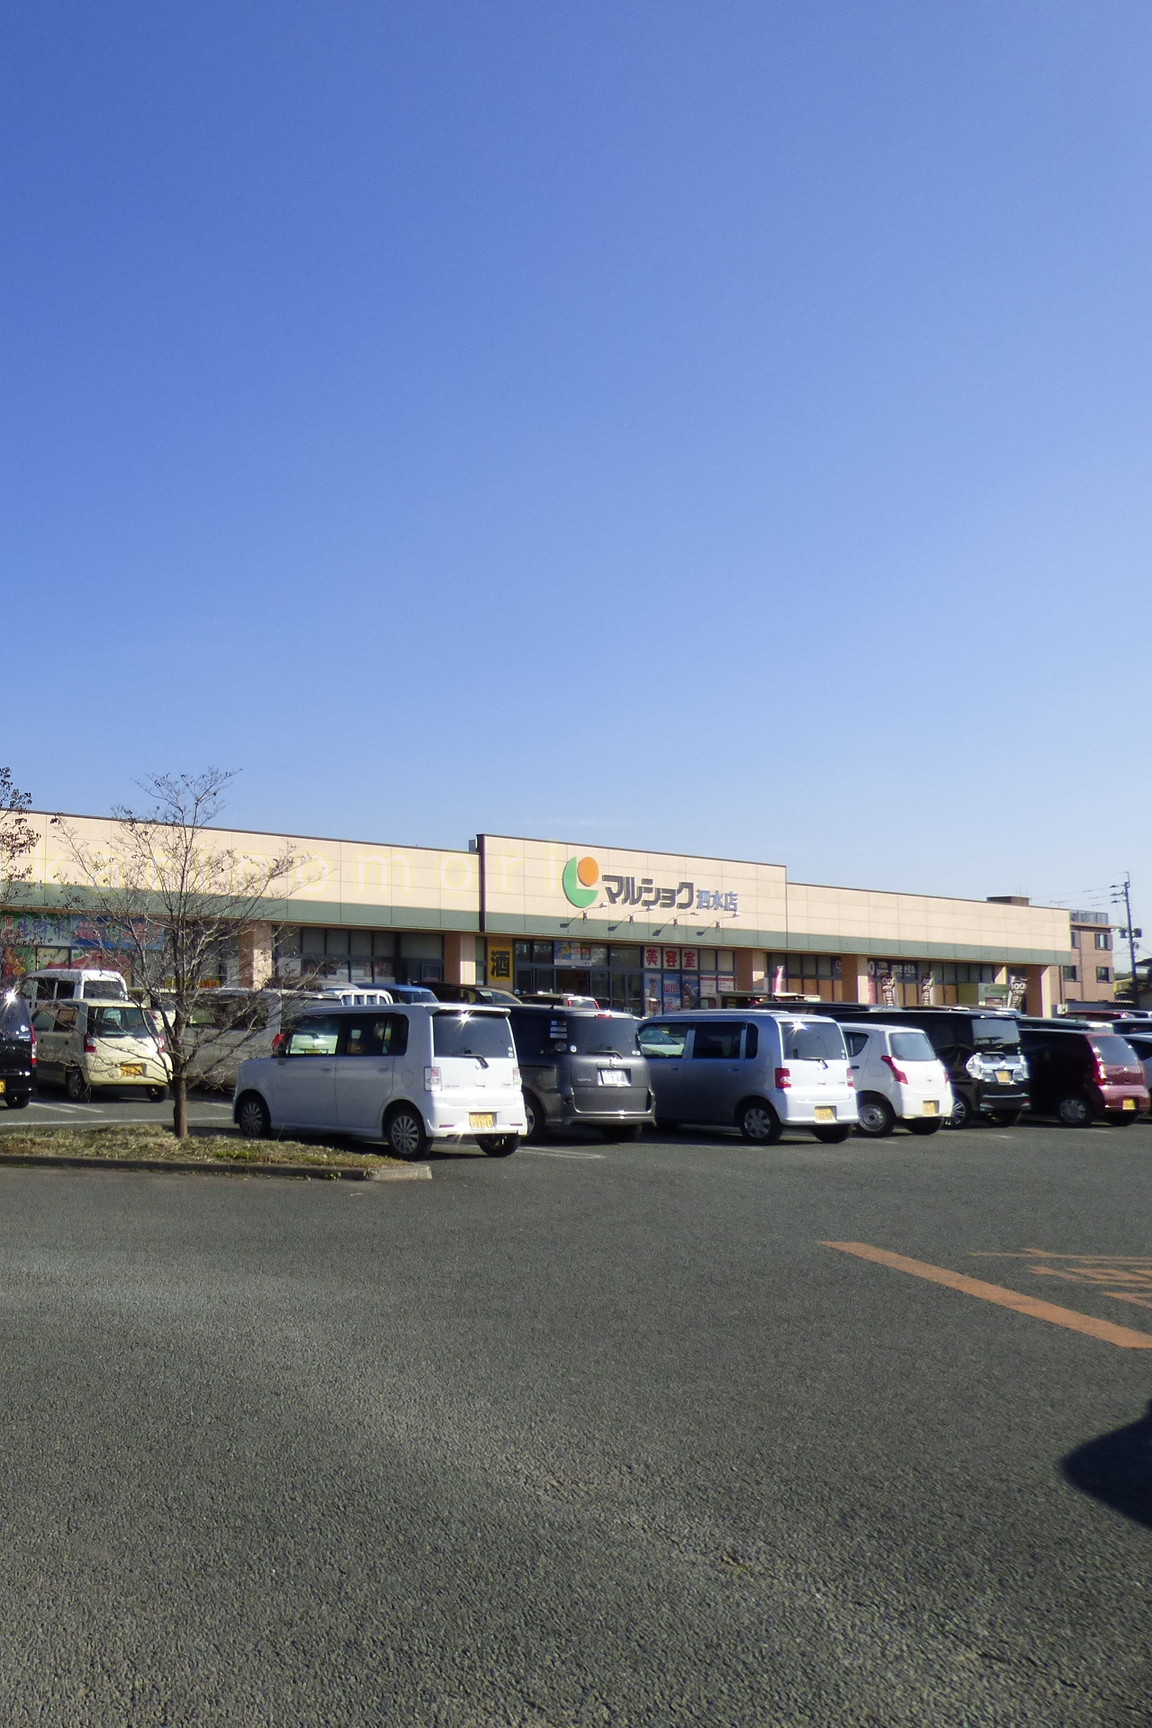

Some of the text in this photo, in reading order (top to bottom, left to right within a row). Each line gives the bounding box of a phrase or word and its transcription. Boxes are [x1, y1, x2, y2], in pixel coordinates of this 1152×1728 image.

[602, 875, 694, 909] マルショク
[491, 950, 510, 978] 酒
[646, 948, 695, 968] 美容室
